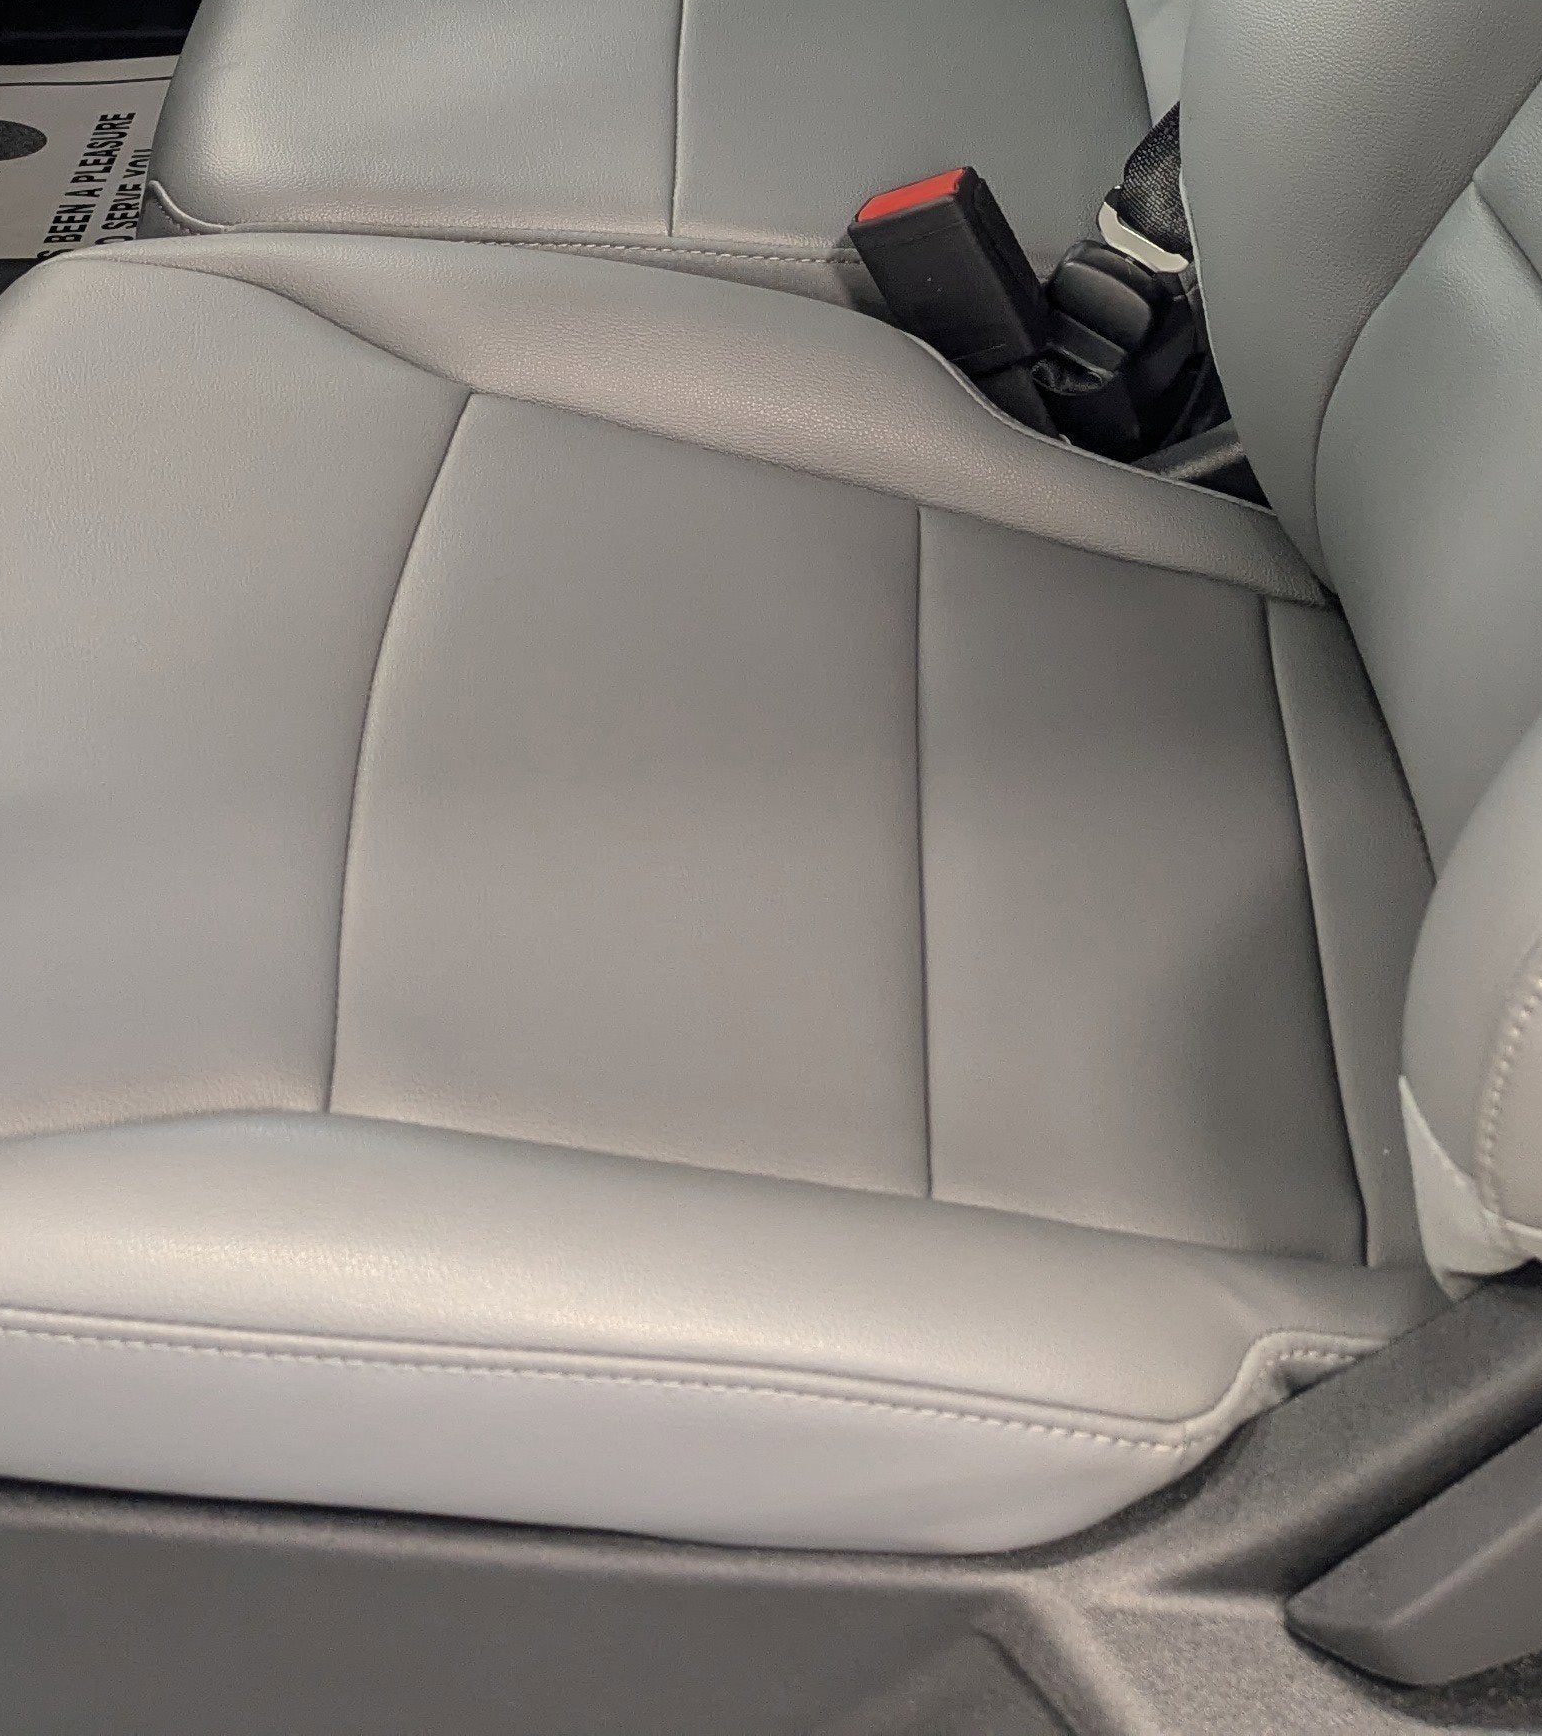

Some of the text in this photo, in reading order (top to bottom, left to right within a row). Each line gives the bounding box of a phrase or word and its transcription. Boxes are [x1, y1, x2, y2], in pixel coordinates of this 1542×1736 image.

[70, 112, 137, 184] PLEASURE
[64, 187, 104, 198] A
[100, 183, 142, 230] SERVE
[43, 203, 96, 244] BEEN
